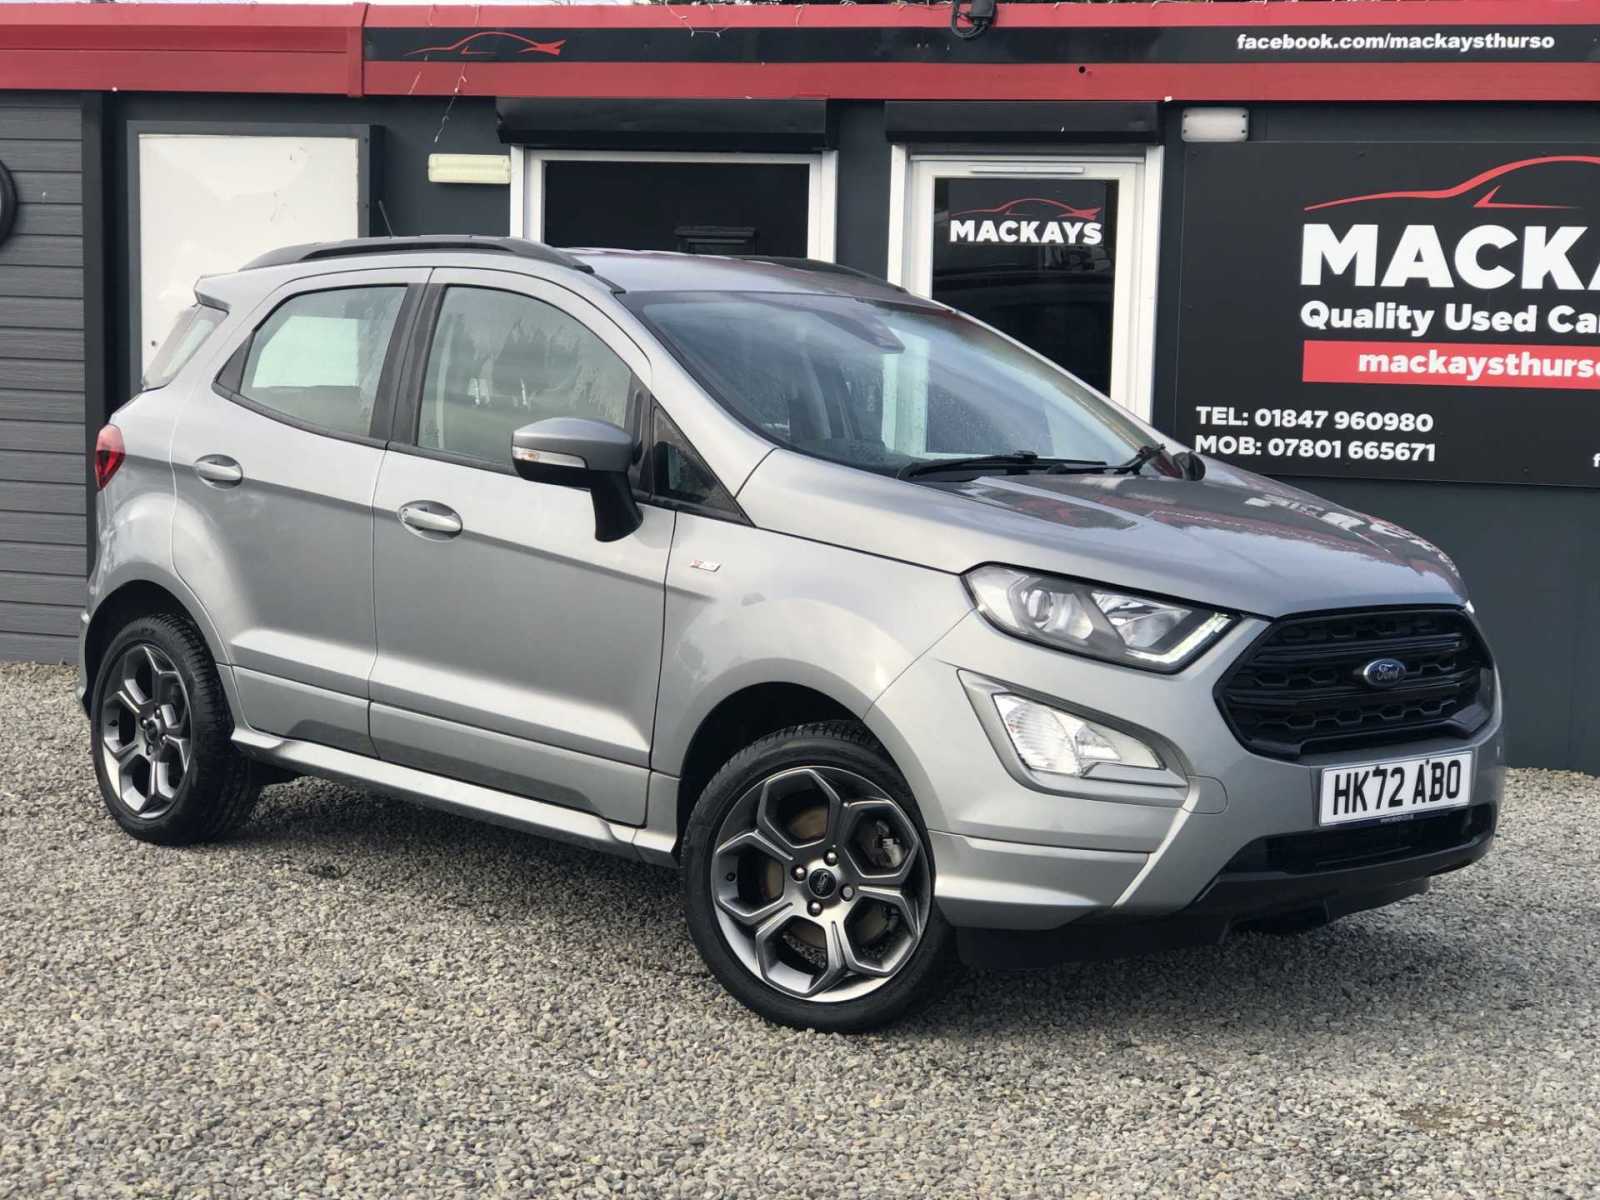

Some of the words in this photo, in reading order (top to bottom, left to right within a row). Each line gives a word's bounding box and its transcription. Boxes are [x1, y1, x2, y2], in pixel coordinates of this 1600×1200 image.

[1237, 32, 1555, 52] facebook.com/mackaysthurso
[949, 219, 1103, 245] MACKAYS
[1300, 223, 1600, 291] MACK
[1300, 300, 1435, 337] Quality
[1445, 303, 1537, 332] Used
[1547, 304, 1600, 333] Ca
[1358, 349, 1600, 381] mackaysthurs
[1196, 406, 1249, 426] TEL:
[1254, 408, 1329, 429] 01847
[1334, 410, 1434, 432] 960980
[1195, 435, 1262, 456] MOB:
[1267, 438, 1342, 459] 07801
[1347, 441, 1436, 462] 665671
[1333, 766, 1405, 815] HK72
[1412, 759, 1461, 804] ABO
